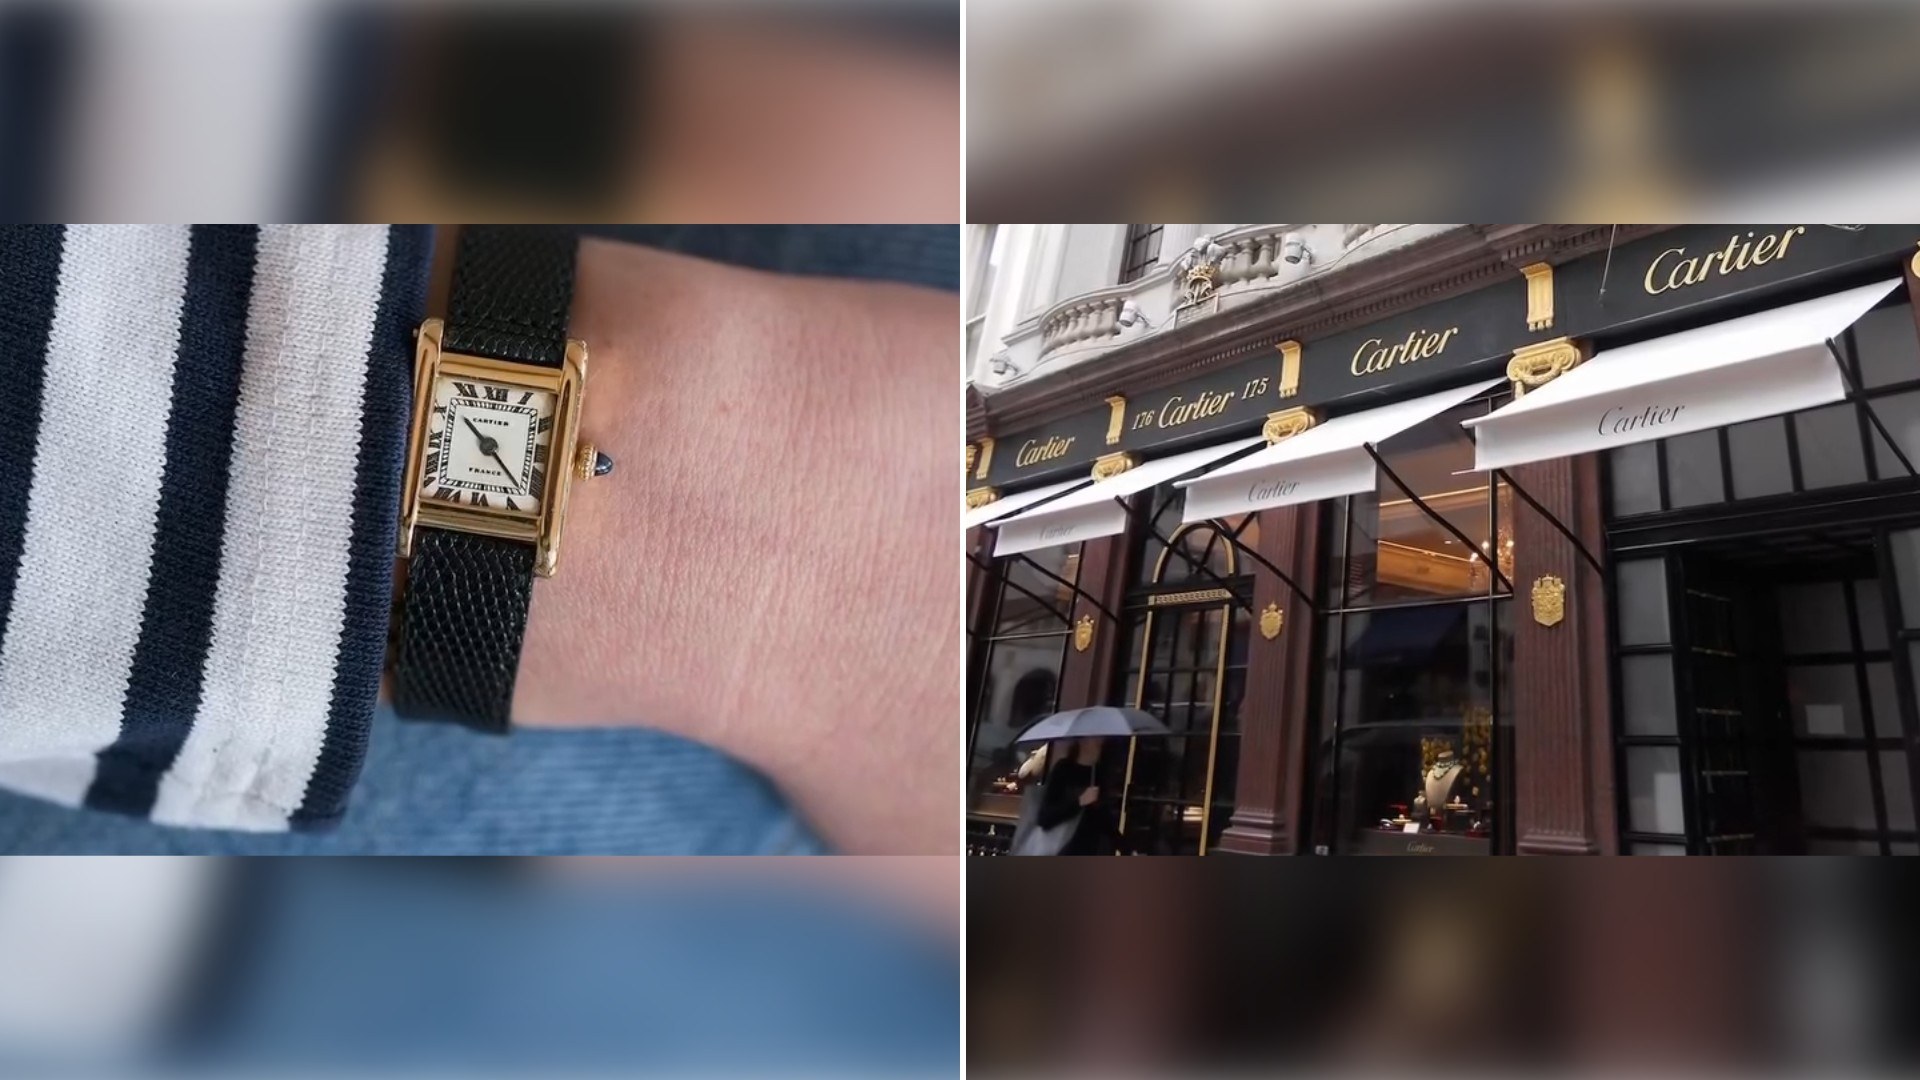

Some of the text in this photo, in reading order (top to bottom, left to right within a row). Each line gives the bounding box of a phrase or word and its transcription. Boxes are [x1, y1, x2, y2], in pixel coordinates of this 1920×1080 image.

[1644, 225, 1805, 294] Cartier
[1350, 326, 1459, 376] Cartier
[1131, 377, 1270, 430] 176 Cartier 175
[472, 416, 509, 427] CARTIER
[1597, 404, 1686, 436] Cartier
[1015, 435, 1077, 468] Cartier
[468, 466, 502, 477] FRANCE
[1247, 479, 1301, 502] Cartier
